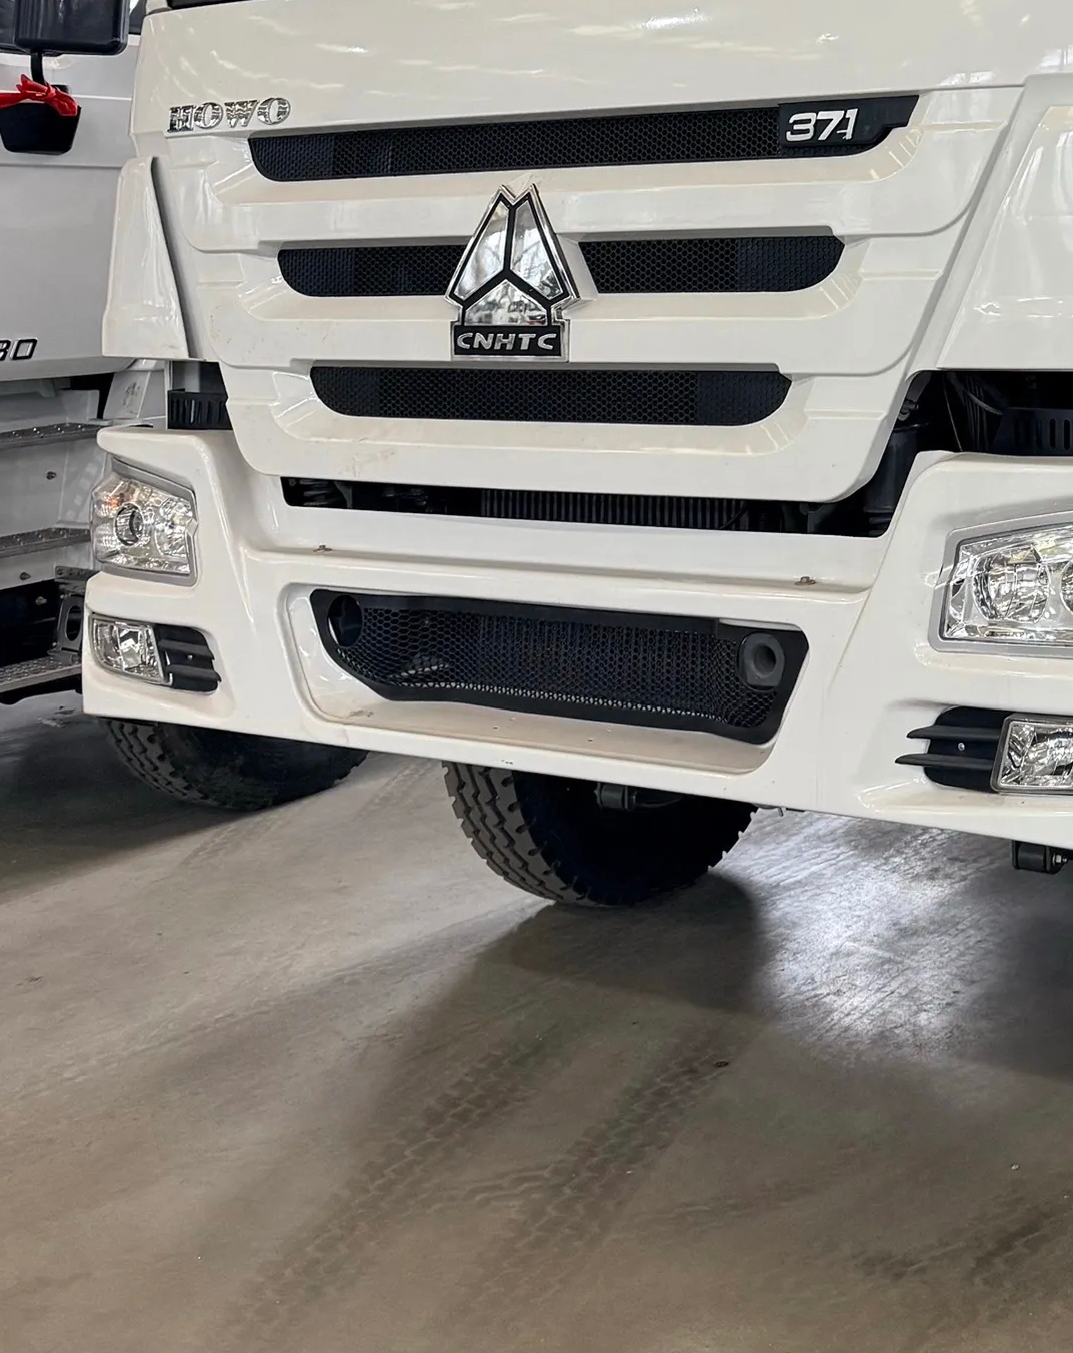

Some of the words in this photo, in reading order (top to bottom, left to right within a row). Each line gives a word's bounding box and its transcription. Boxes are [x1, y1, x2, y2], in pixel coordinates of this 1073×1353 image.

[167, 97, 291, 133] HOWO
[785, 108, 859, 142] 371
[456, 332, 557, 350] CNHTC
